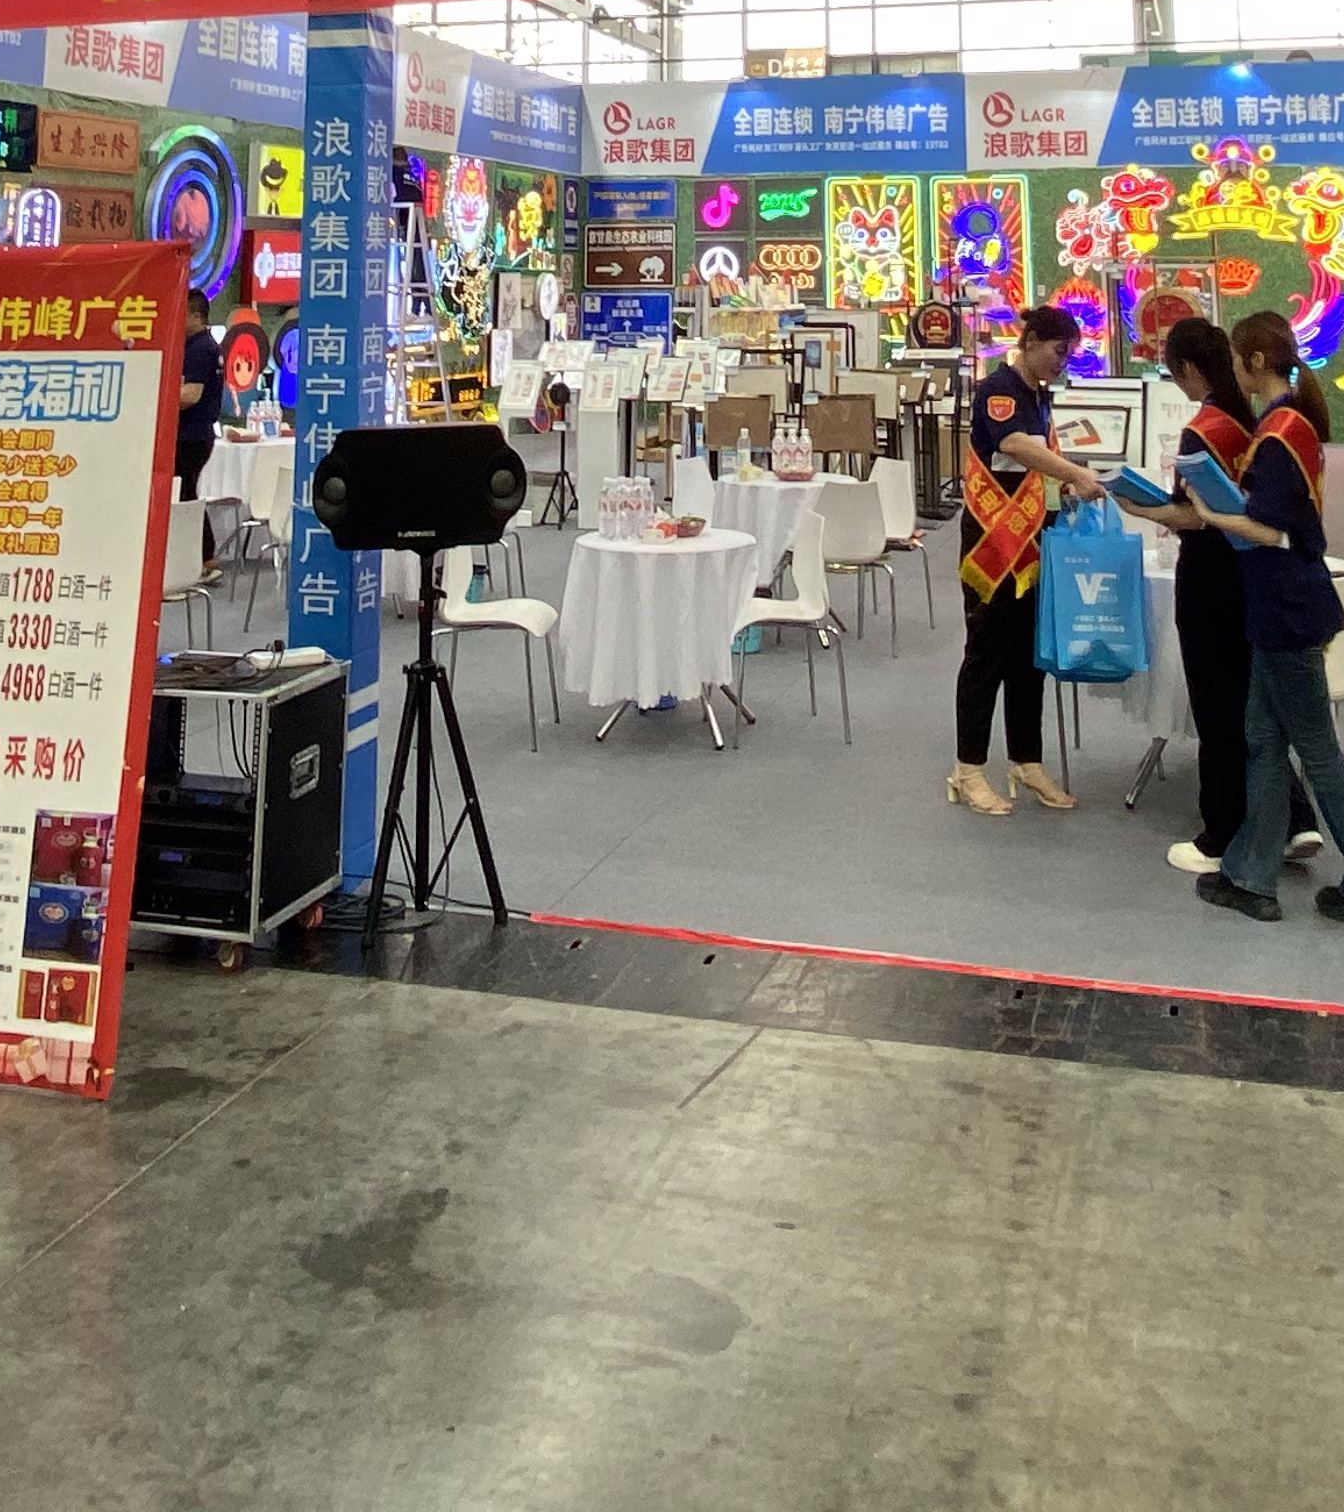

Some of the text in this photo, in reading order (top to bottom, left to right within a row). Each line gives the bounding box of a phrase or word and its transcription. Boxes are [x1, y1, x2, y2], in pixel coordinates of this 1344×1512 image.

[64, 24, 165, 85] 浪歌集团
[197, 17, 279, 71] 全国连锁
[637, 116, 676, 131] LAGR
[732, 103, 949, 137] 全国连锁 南宁伟峰广告
[1021, 108, 1066, 122] LAGR
[1131, 97, 1224, 129] 全国连锁
[603, 138, 696, 164] 浪歌集团
[984, 130, 1088, 158] 浪歌集团
[309, 116, 353, 300] 浪歌集团
[364, 117, 389, 298] 浪歌集团
